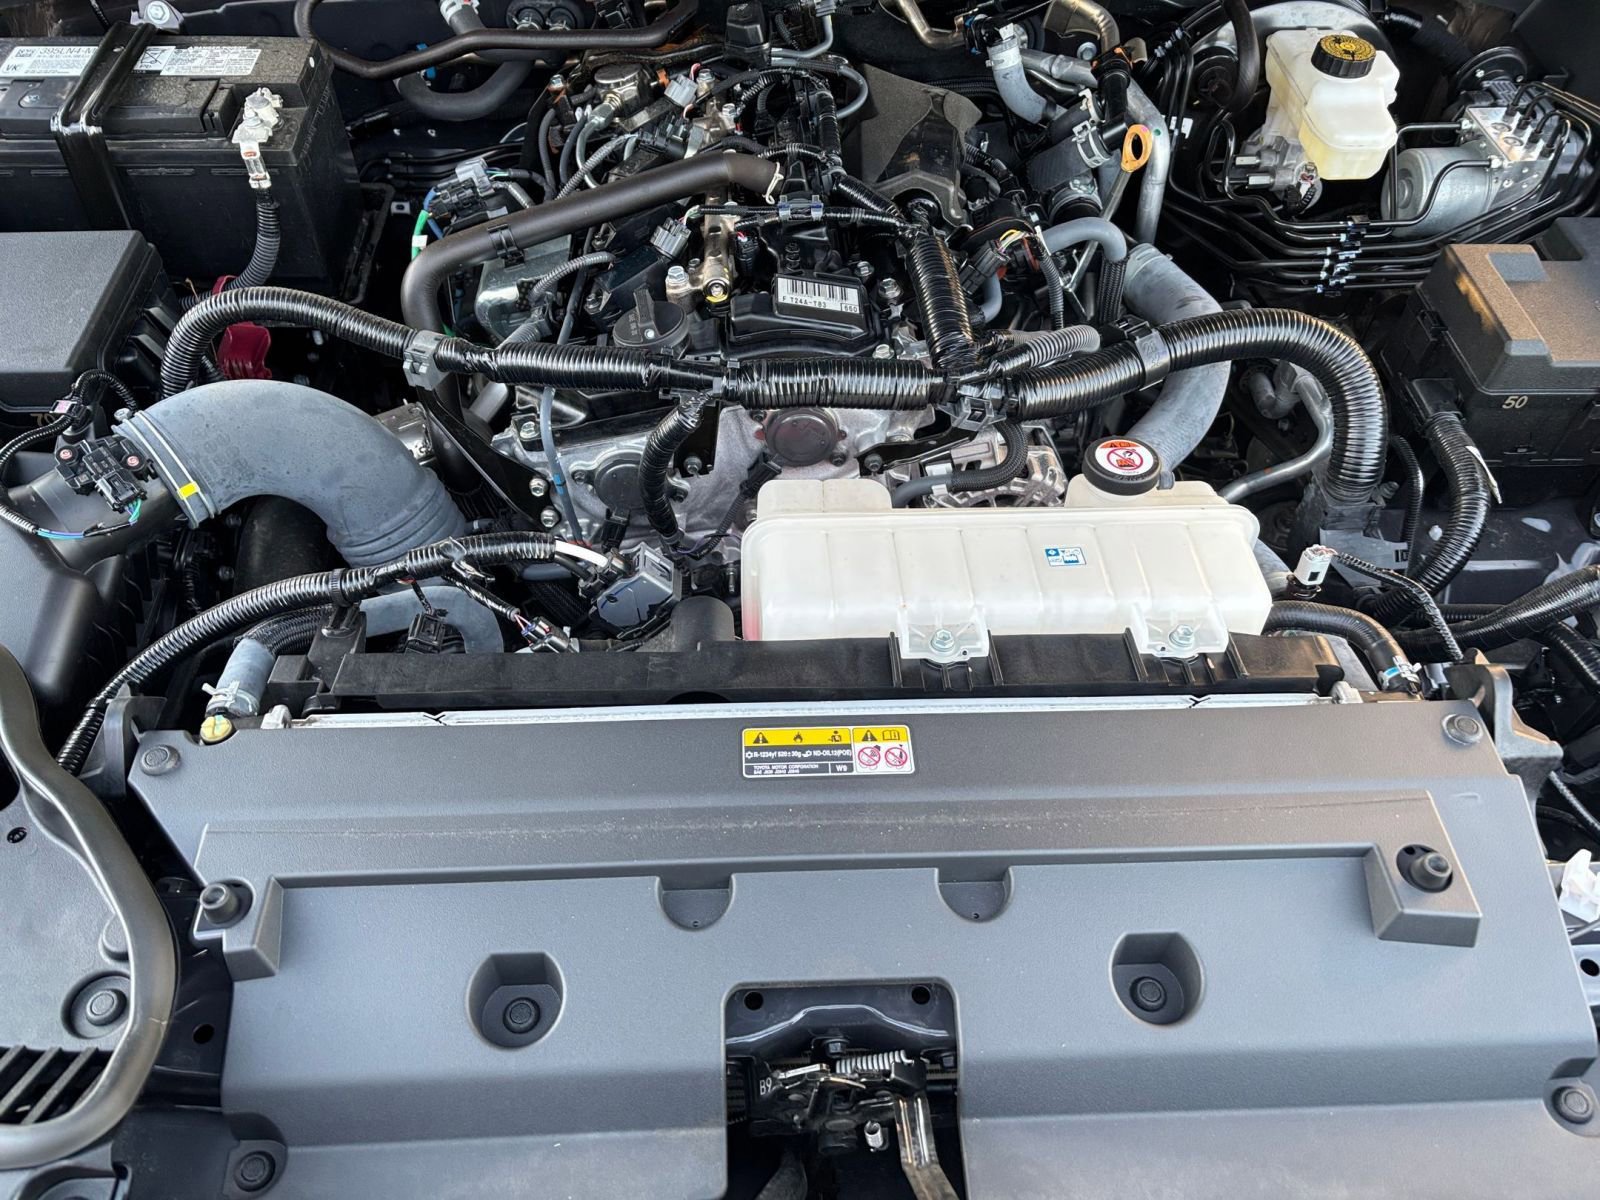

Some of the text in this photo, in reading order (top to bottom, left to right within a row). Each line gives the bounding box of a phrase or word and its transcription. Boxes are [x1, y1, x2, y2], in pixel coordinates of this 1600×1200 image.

[1502, 396, 1528, 408] 50
[836, 764, 848, 772] W9
[760, 1077, 772, 1095] B9
